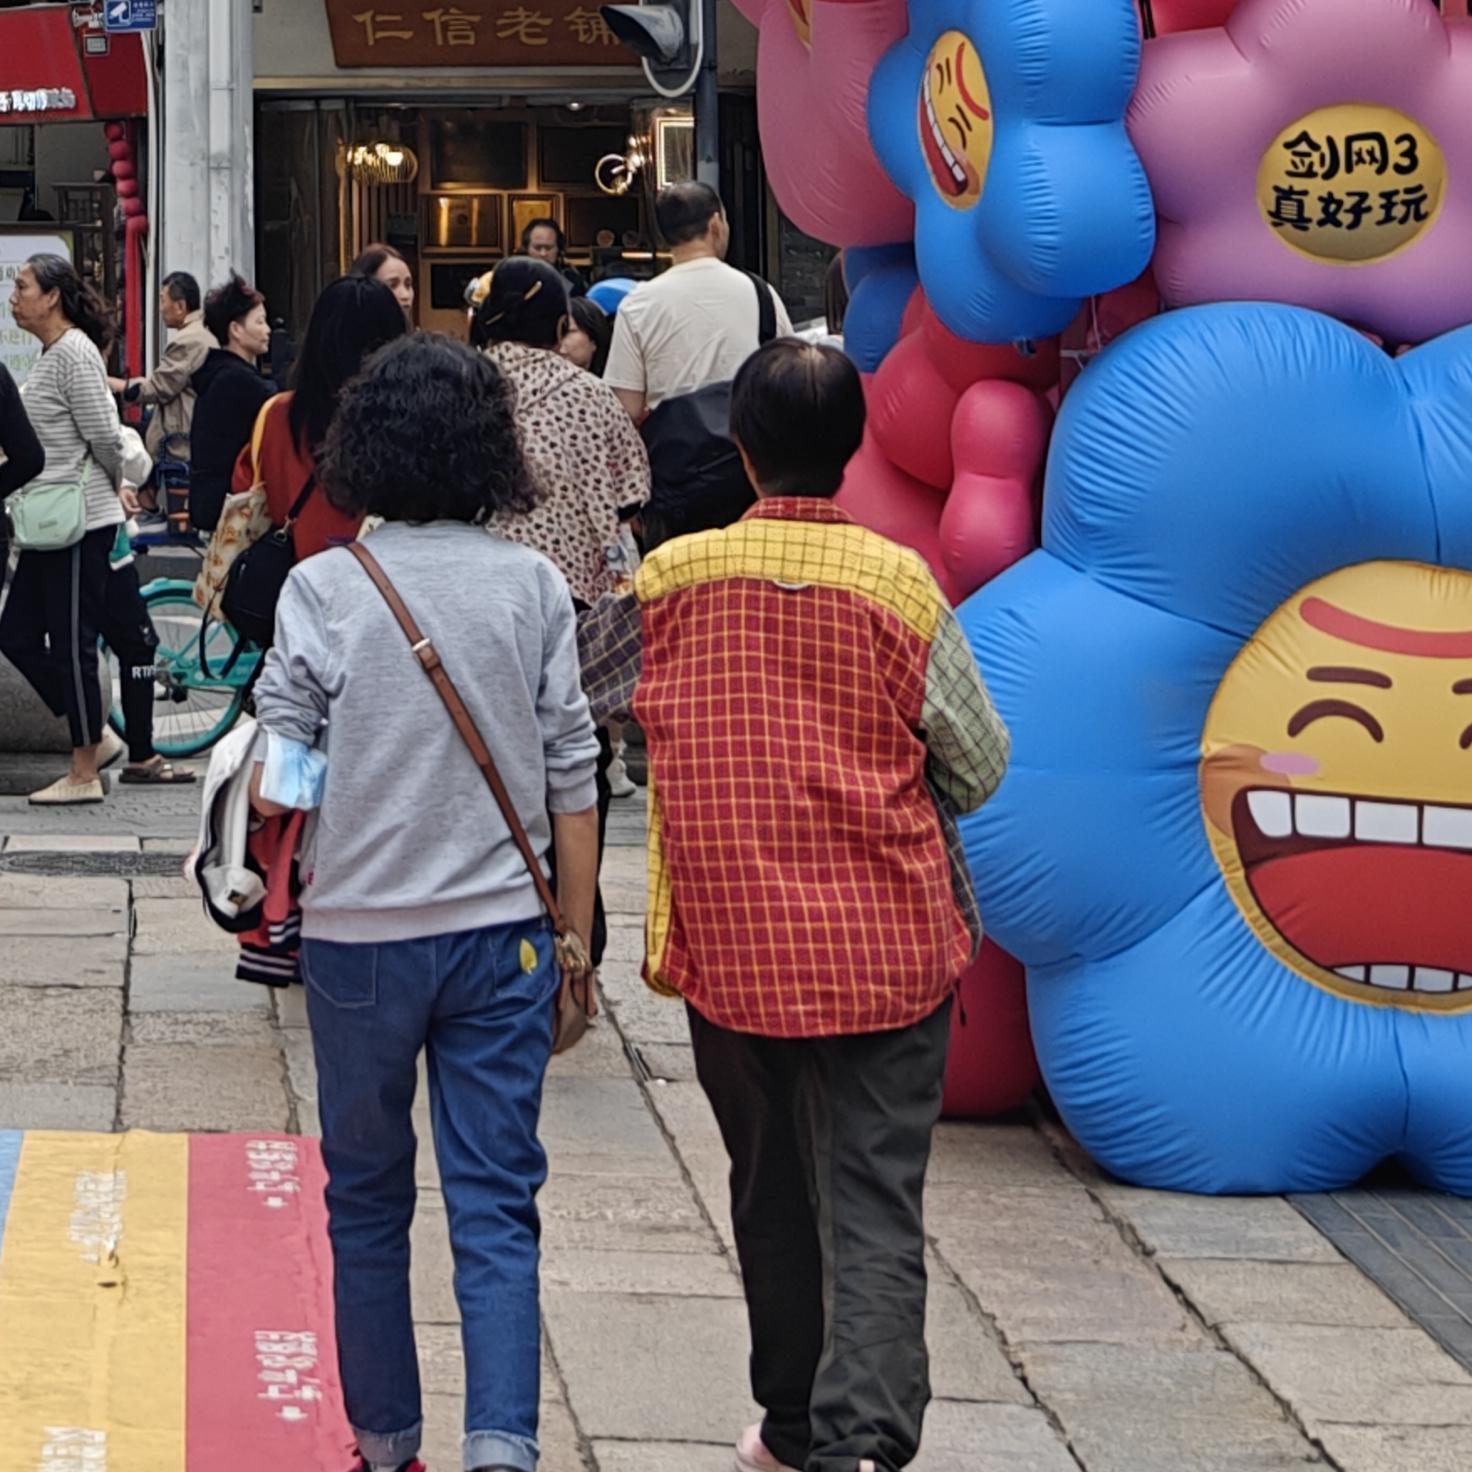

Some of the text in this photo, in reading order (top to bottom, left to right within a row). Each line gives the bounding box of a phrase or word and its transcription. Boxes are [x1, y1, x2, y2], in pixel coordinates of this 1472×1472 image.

[352, 5, 621, 46] 仁信老铺
[1282, 129, 1419, 179] 剑网3
[1267, 183, 1432, 232] 真好玩
